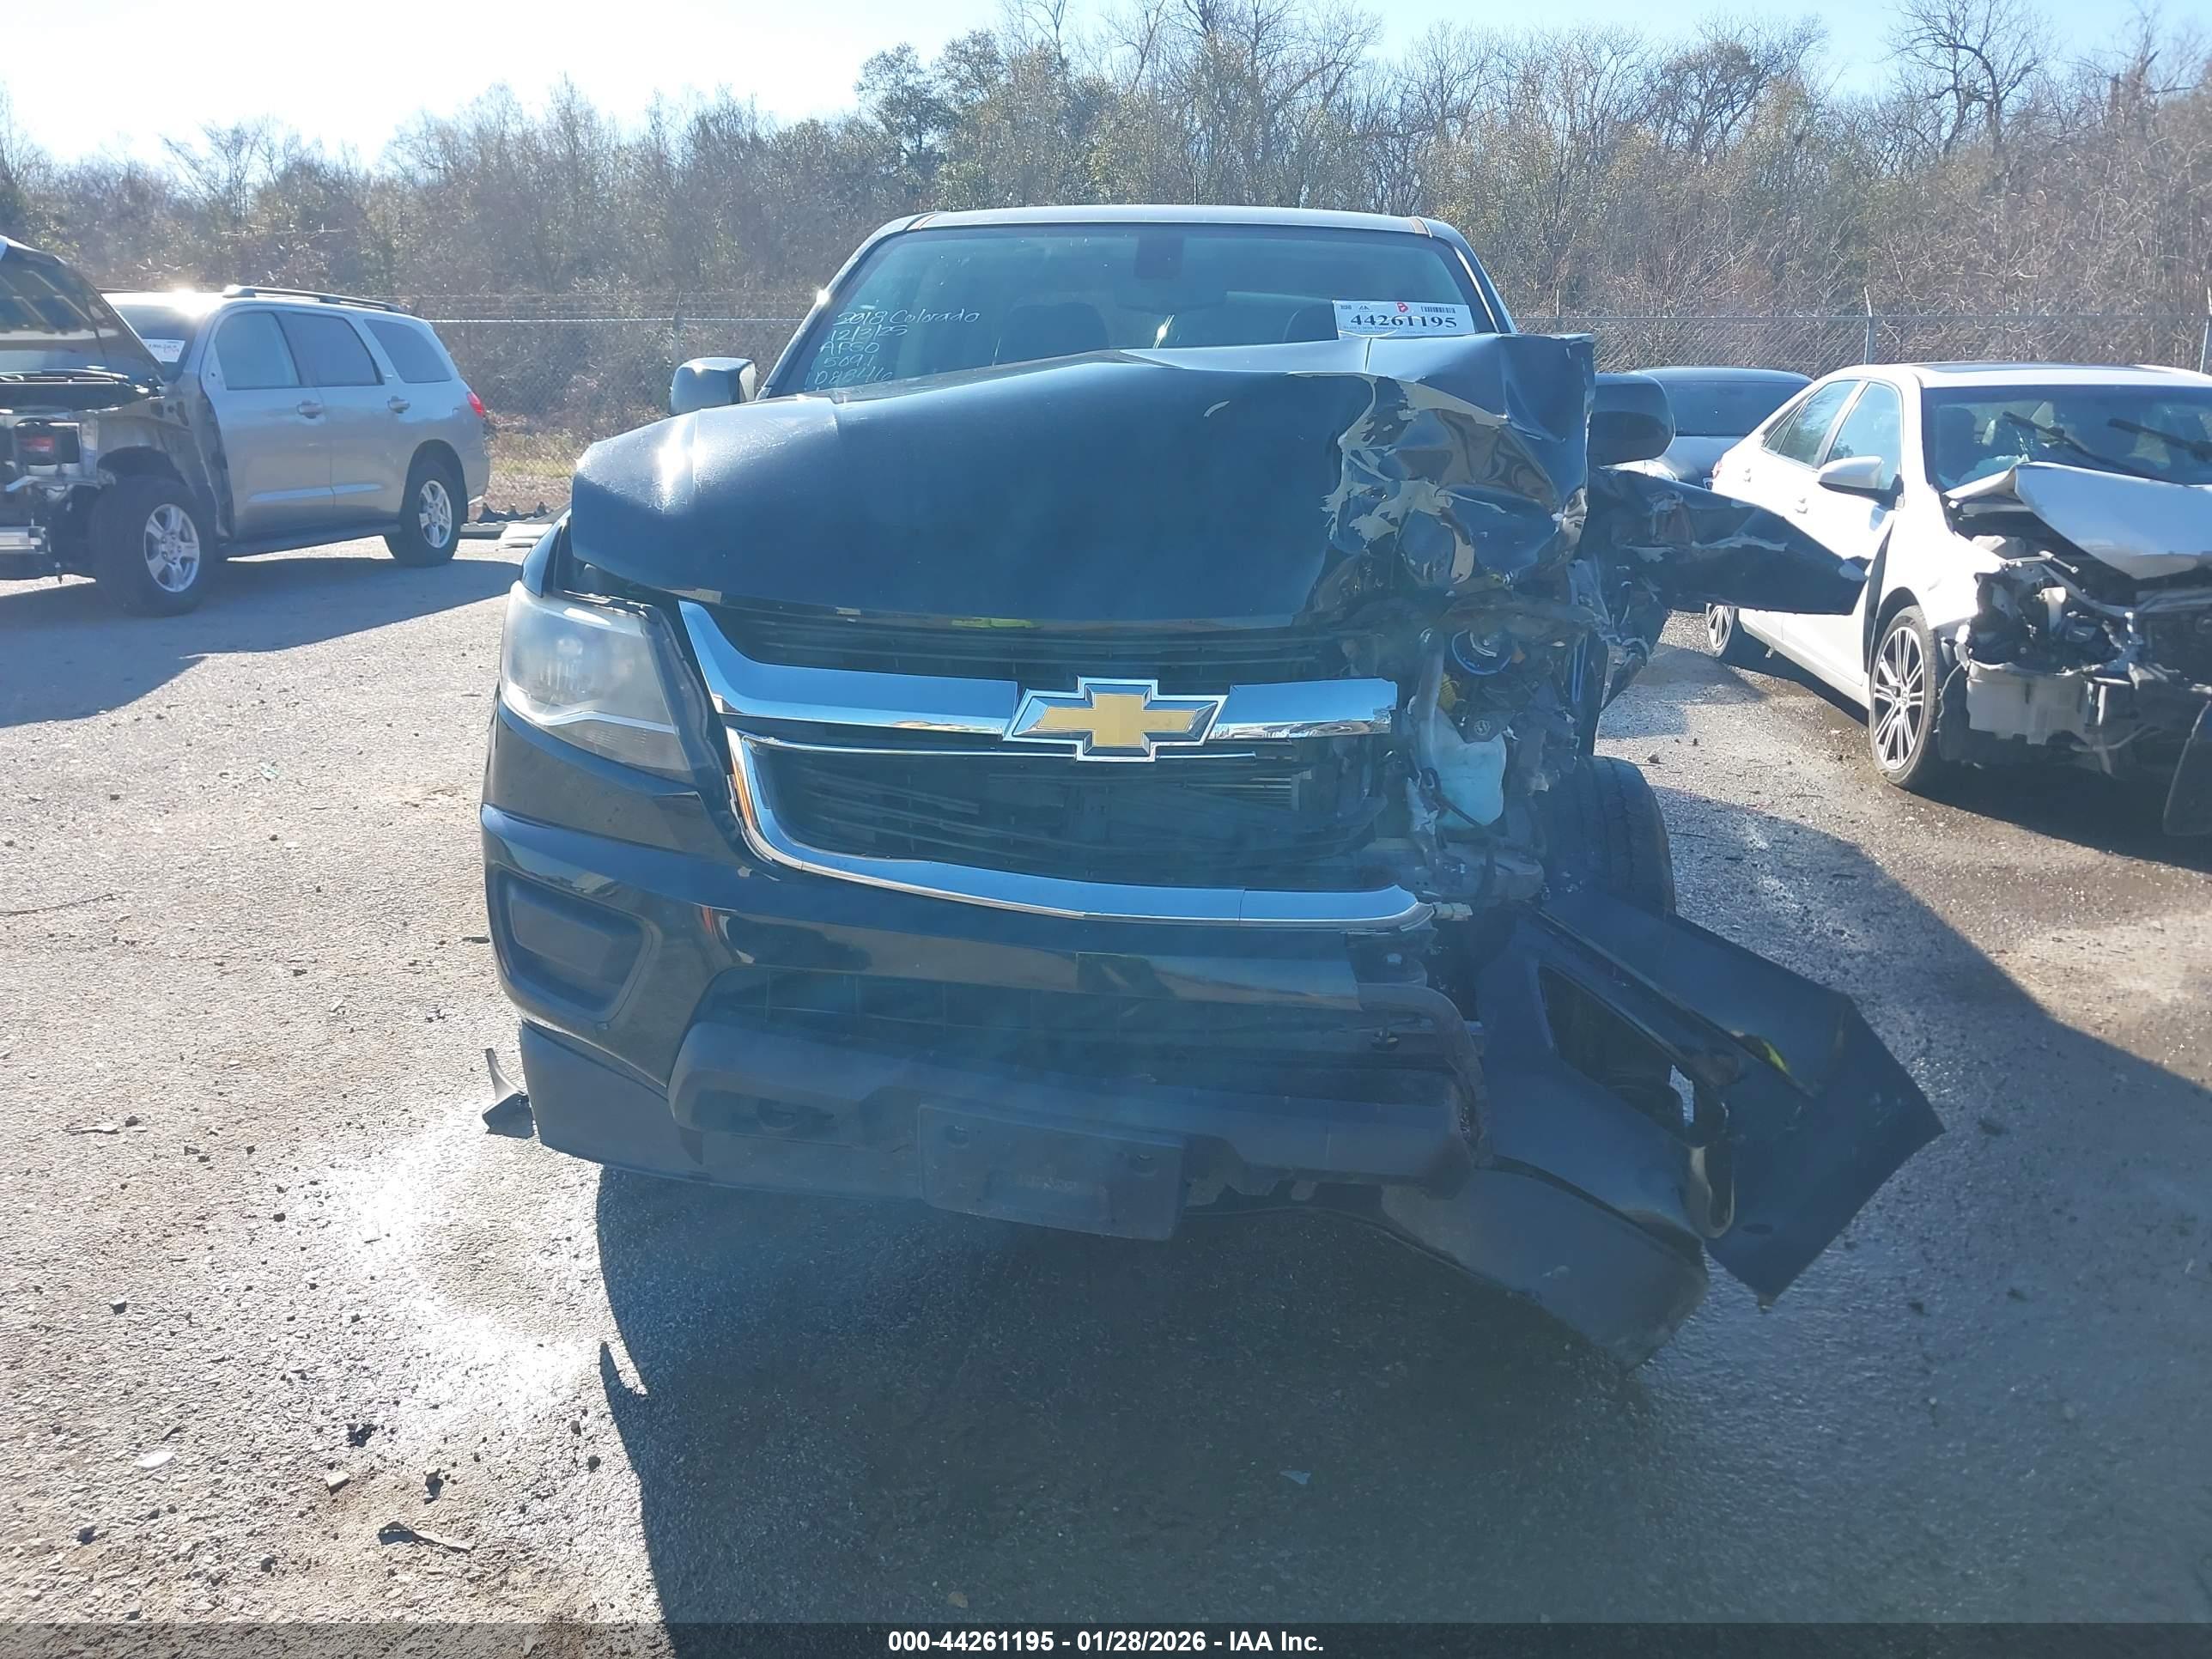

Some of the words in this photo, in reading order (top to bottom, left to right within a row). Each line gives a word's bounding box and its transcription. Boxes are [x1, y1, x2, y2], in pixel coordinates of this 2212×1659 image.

[832, 310, 888, 325] 2018
[890, 309, 981, 324] Colorado
[1350, 314, 1457, 329] 44261195
[830, 325, 908, 342] 12/3/25
